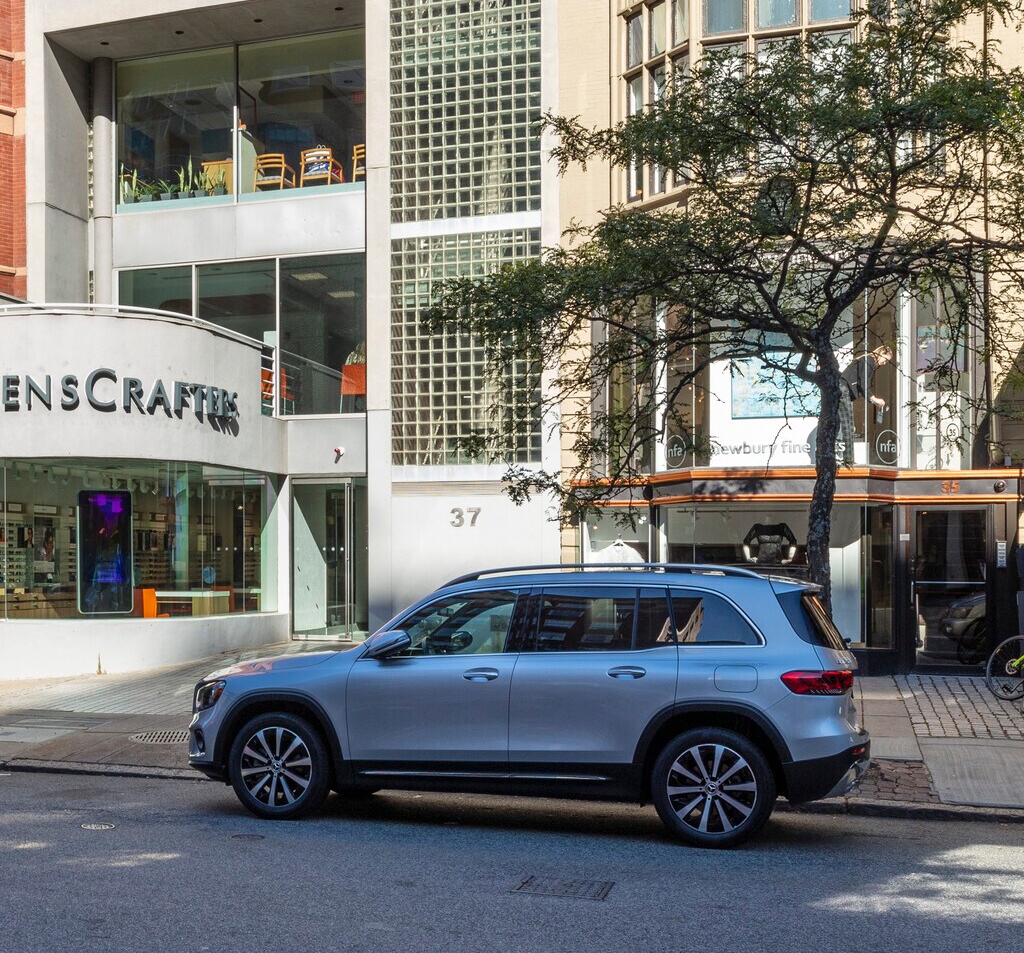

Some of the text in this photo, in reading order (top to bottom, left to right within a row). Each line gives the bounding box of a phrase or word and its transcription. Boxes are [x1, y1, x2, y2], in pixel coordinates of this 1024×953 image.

[780, 440, 811, 454] fine
[880, 440, 897, 454] nfa
[940, 480, 961, 493] 35
[449, 507, 482, 527] 37
